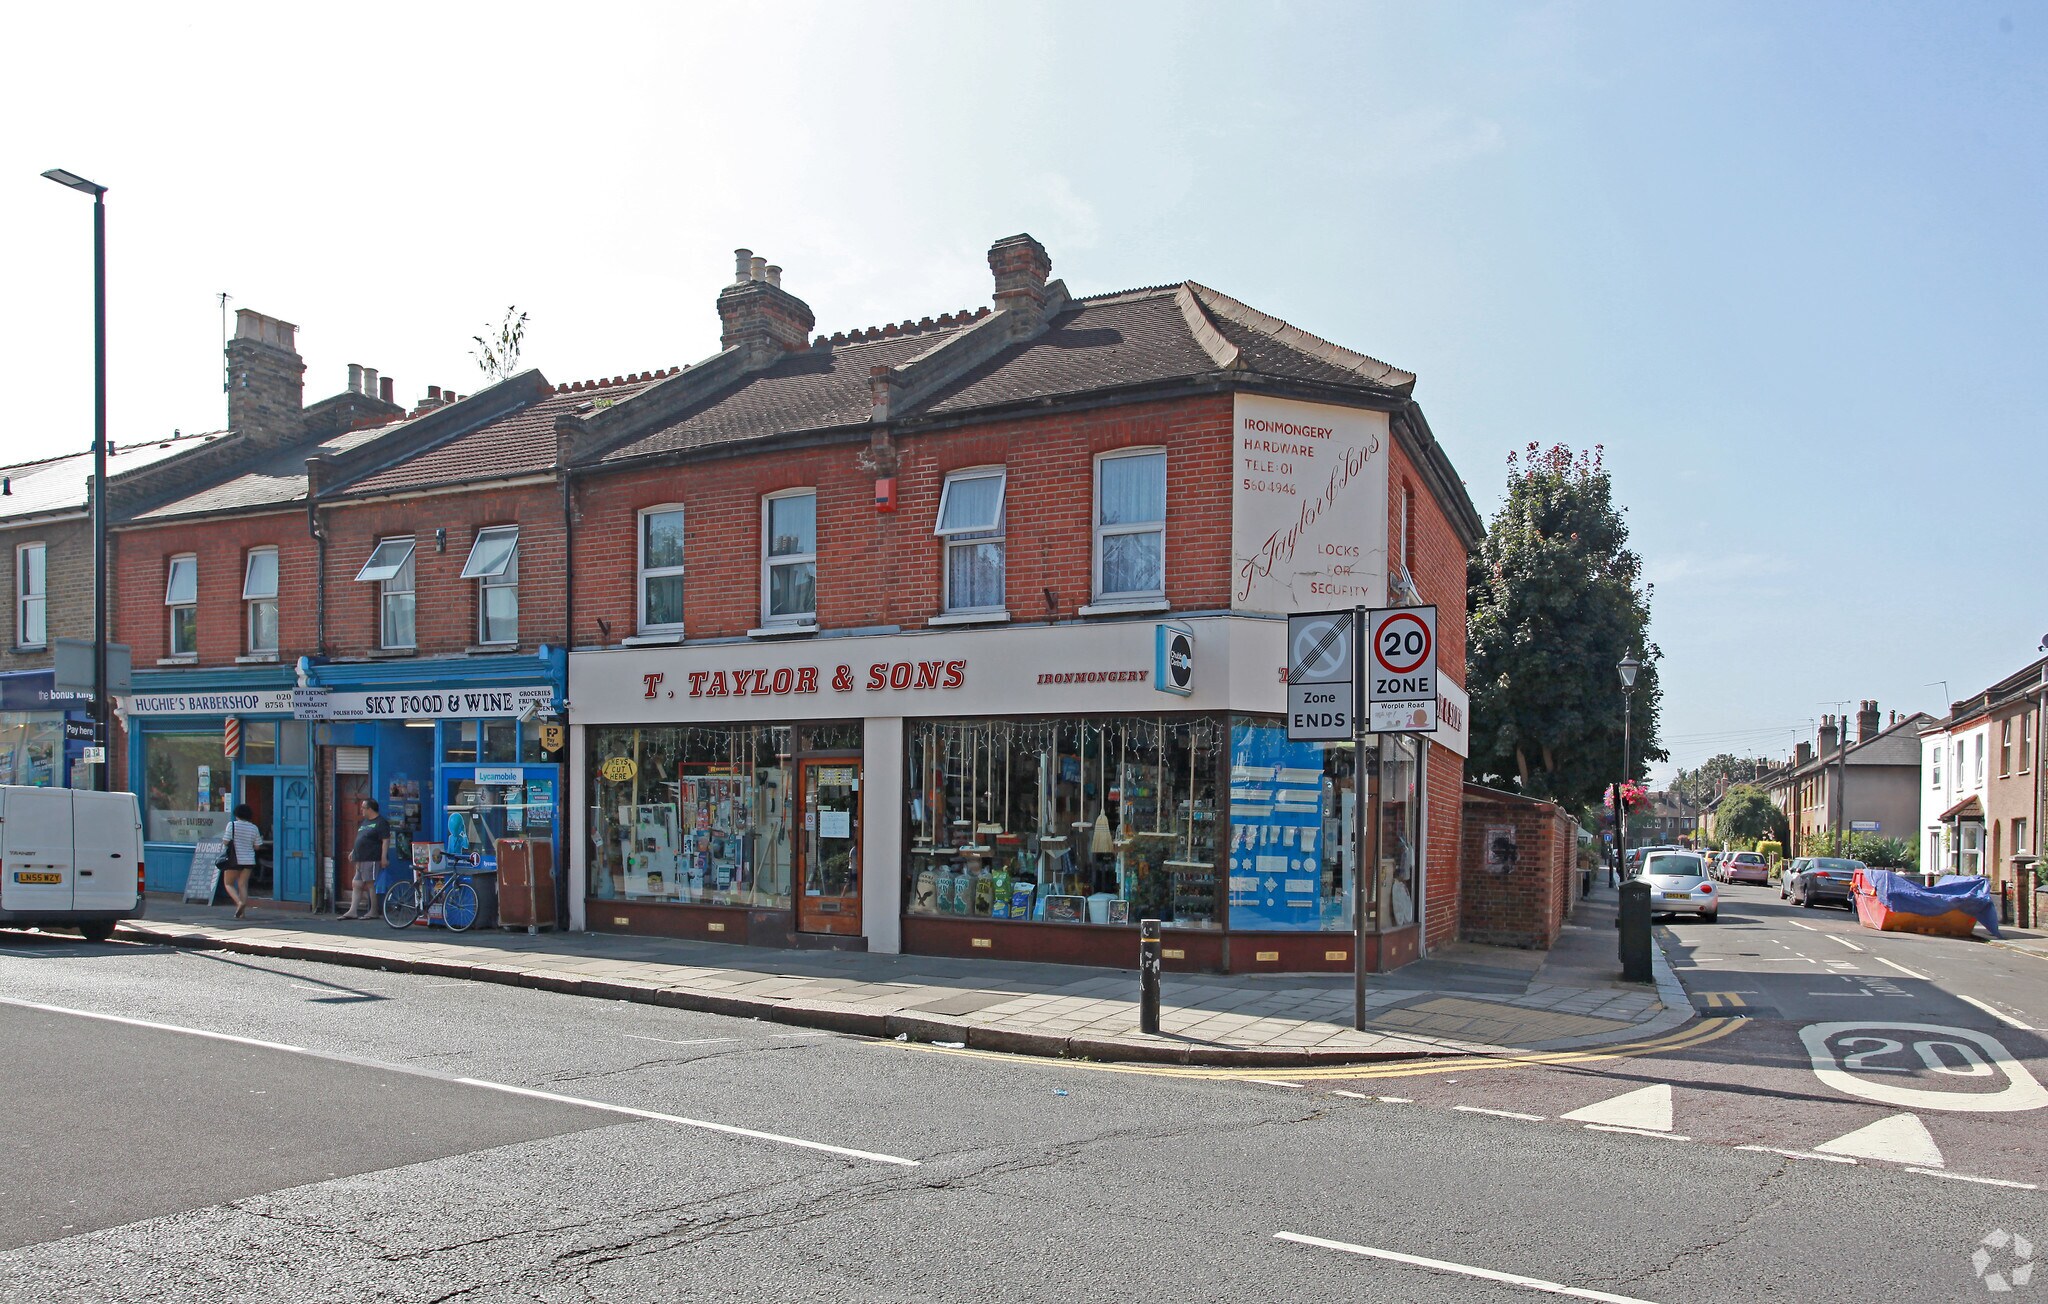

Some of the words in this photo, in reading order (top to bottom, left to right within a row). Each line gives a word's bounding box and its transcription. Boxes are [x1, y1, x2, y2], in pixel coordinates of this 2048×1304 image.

[1244, 418, 1333, 440] IRONMONGERY
[1244, 439, 1314, 458] HARDWARE
[1260, 498, 1322, 577] Taylor
[1338, 434, 1380, 490] Sons
[1318, 544, 1360, 557] LOCKS
[1384, 630, 1424, 656] 20
[688, 666, 820, 698] TAYLOR
[831, 664, 855, 692] &
[866, 659, 967, 691] SONS
[1036, 670, 1149, 684] IRONMONGERY
[1376, 678, 1429, 694] ZONE
[38, 690, 48, 700] the
[50, 690, 74, 700] bonus
[366, 696, 396, 714] SKY
[400, 695, 444, 714] FOOD
[448, 694, 460, 712] &
[464, 692, 514, 712] WINE
[1304, 692, 1336, 704] Zone
[136, 698, 186, 712] HUGHIE'S
[189, 695, 260, 710] BARBERSHOP
[1294, 712, 1346, 728] ENDS
[67, 724, 78, 736] Pay
[80, 726, 93, 736] here
[612, 758, 628, 766] KEYS
[480, 772, 516, 781] Lycamobile
[44, 874, 60, 882] WZY
[1837, 1036, 1994, 1076] 20
